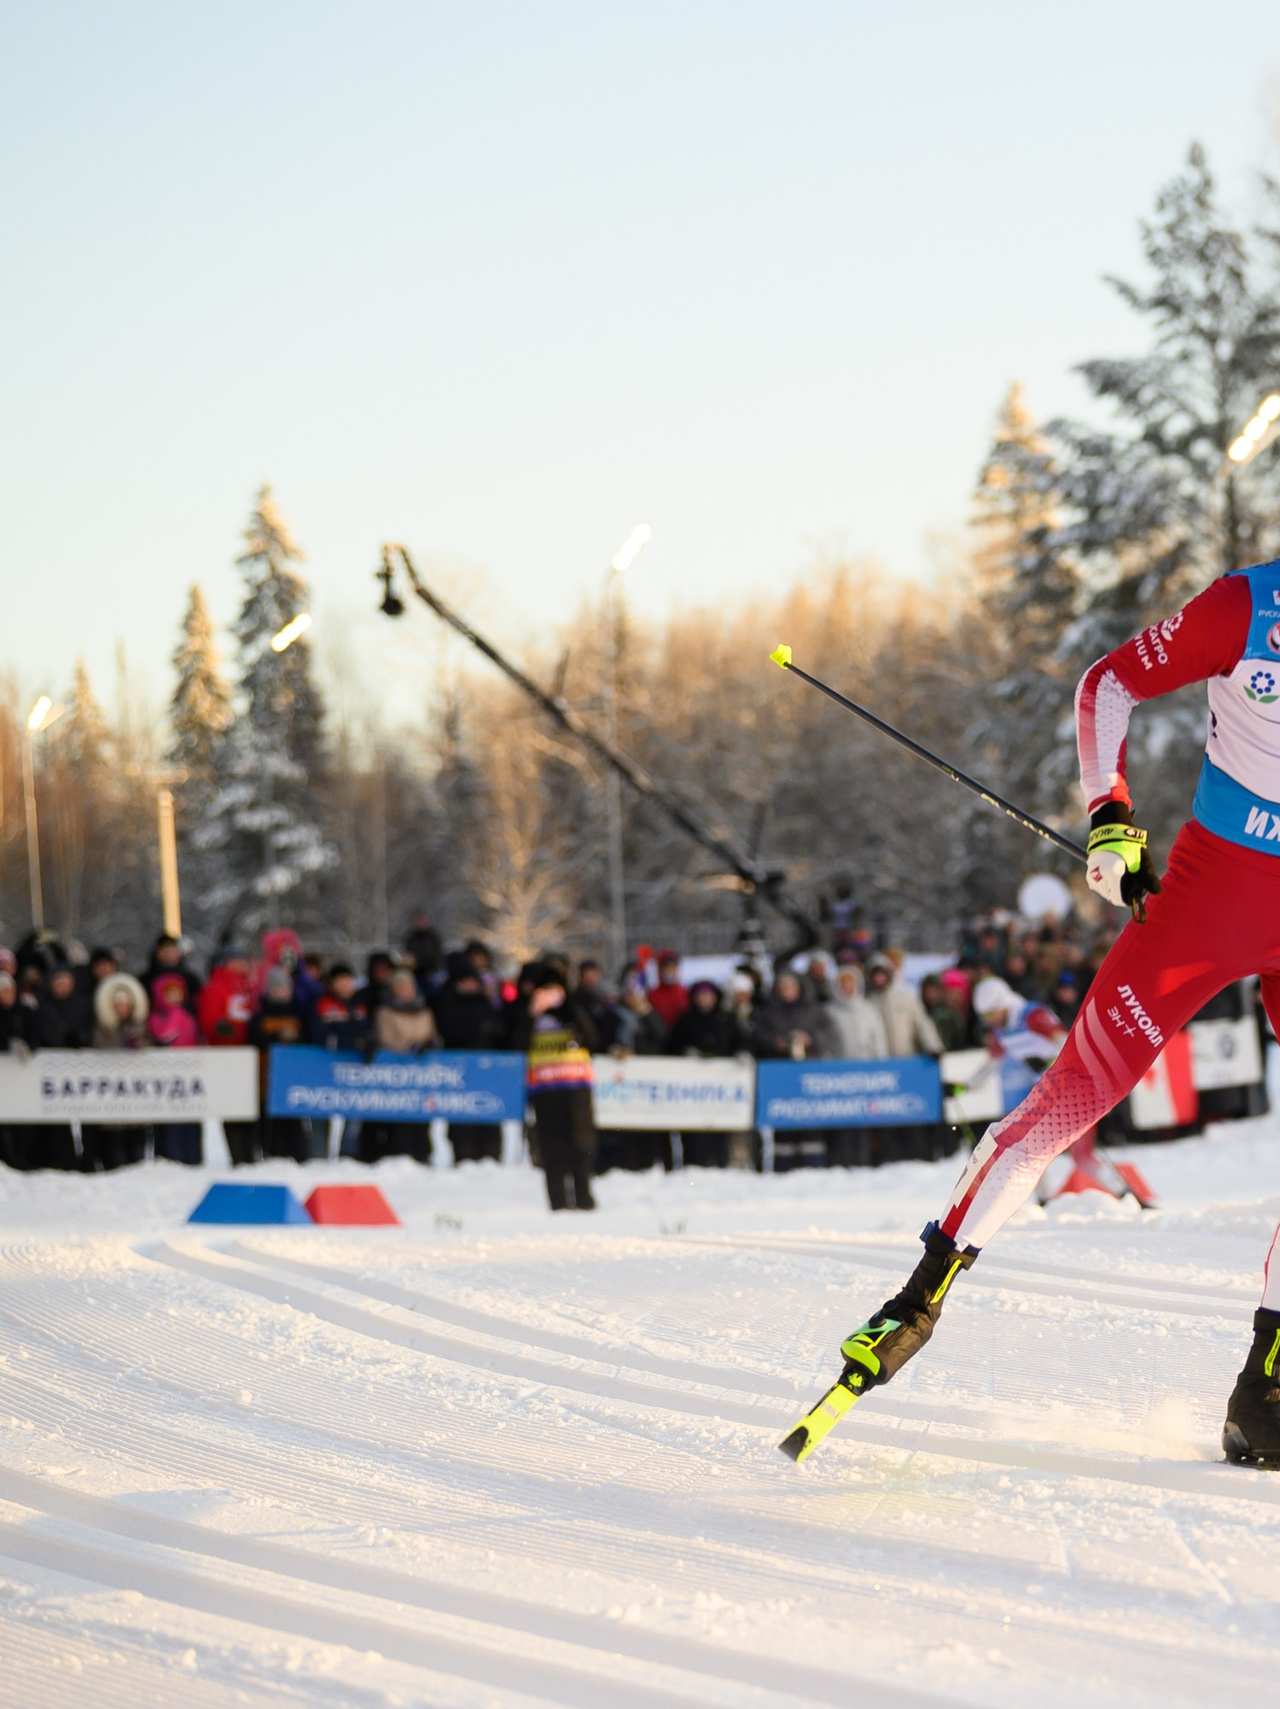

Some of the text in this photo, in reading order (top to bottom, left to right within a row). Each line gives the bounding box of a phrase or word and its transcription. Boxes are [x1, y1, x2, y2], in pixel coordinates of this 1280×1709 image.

[1107, 1005, 1137, 1038] ЭН+
[1117, 984, 1164, 1048] ЛУКОЙЛ
[331, 1061, 465, 1087] ТЕХНОПАРК
[40, 1075, 207, 1102] БАРРАКУДА
[287, 1086, 421, 1112] РУСКЛИМАТ
